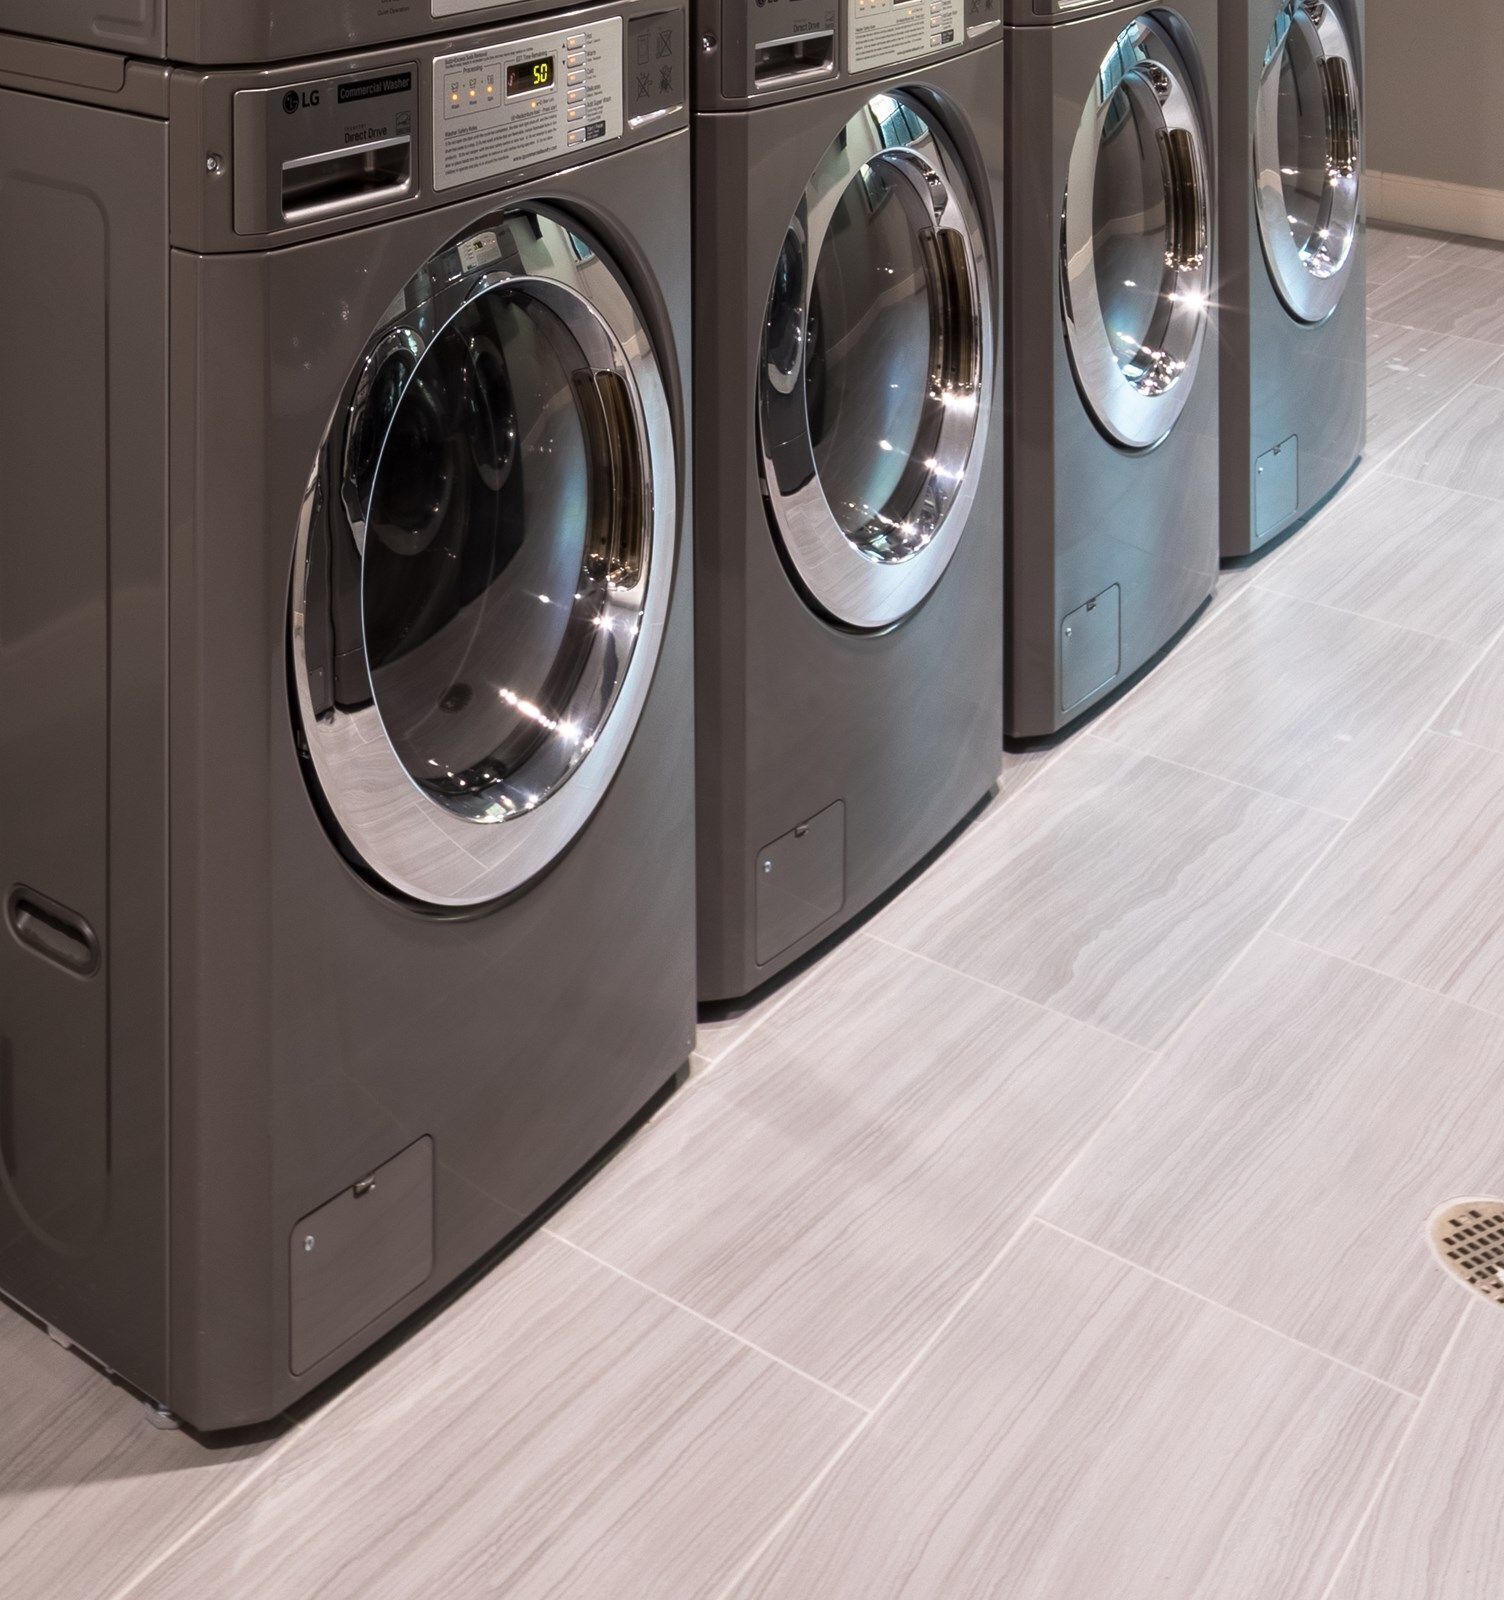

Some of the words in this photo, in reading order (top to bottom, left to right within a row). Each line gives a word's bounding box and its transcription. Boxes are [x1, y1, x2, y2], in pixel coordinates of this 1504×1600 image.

[533, 63, 548, 85] 50
[340, 82, 382, 99] Commercial
[383, 78, 410, 91] Washer
[302, 90, 320, 108] LG
[344, 130, 367, 143] Direct
[368, 127, 387, 140] Drive
